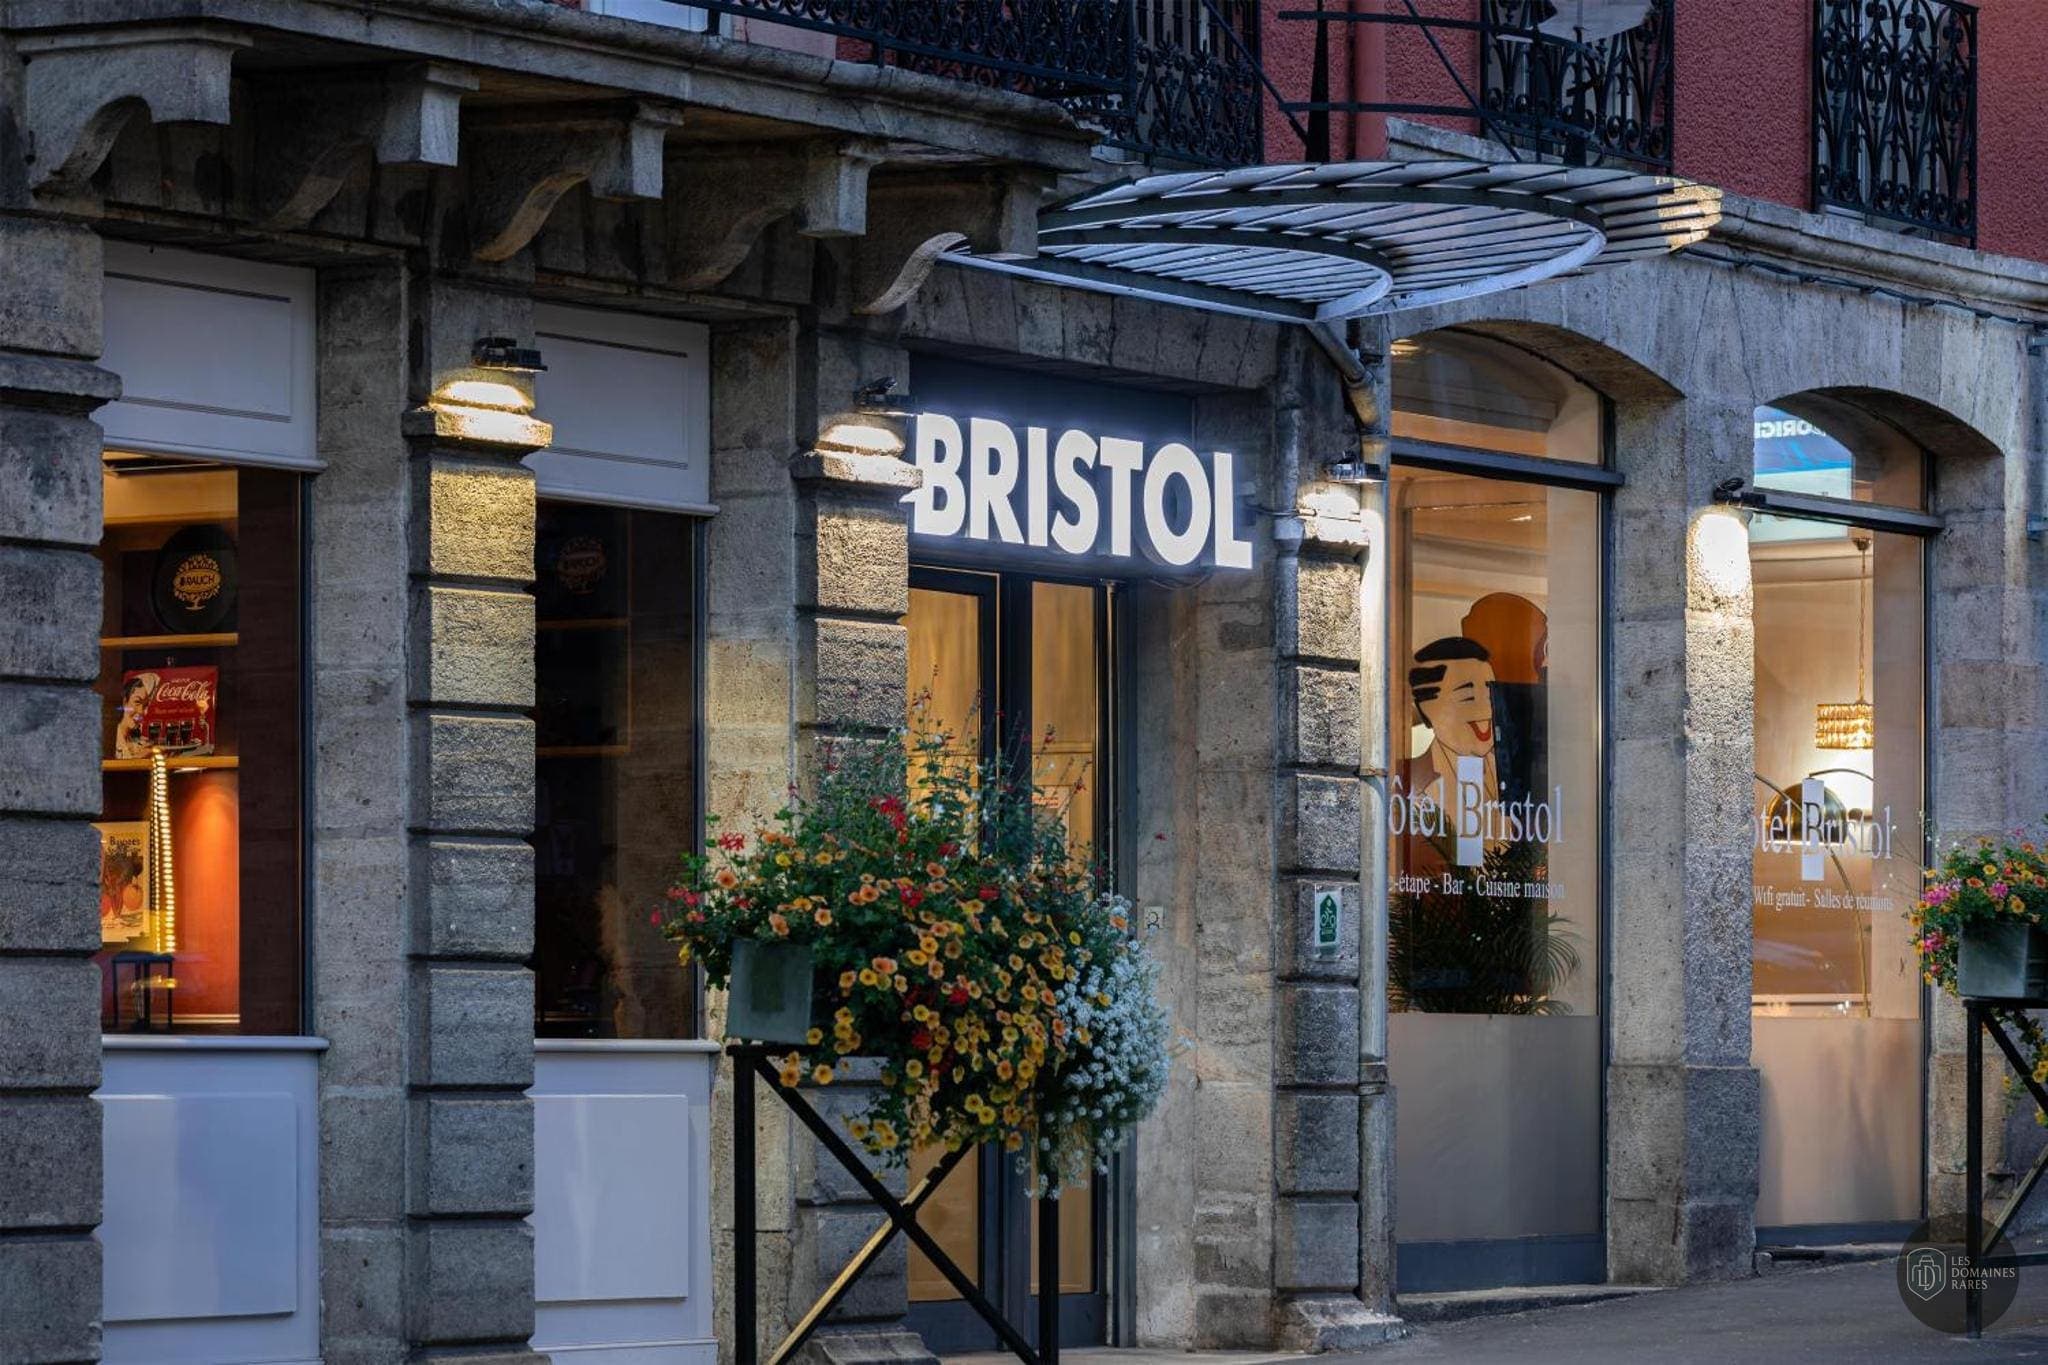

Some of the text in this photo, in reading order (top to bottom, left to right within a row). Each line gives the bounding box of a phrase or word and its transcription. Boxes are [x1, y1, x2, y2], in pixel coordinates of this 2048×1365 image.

[912, 412, 1253, 570] BRISTOL
[1388, 774, 1566, 844] ôtel Bristol
[1750, 799, 1893, 860] tel Bristol
[1441, 872, 1465, 895] Bar
[1476, 874, 1520, 898] Cuisine
[1524, 877, 1566, 899] maison
[1815, 887, 1840, 909] Salles
